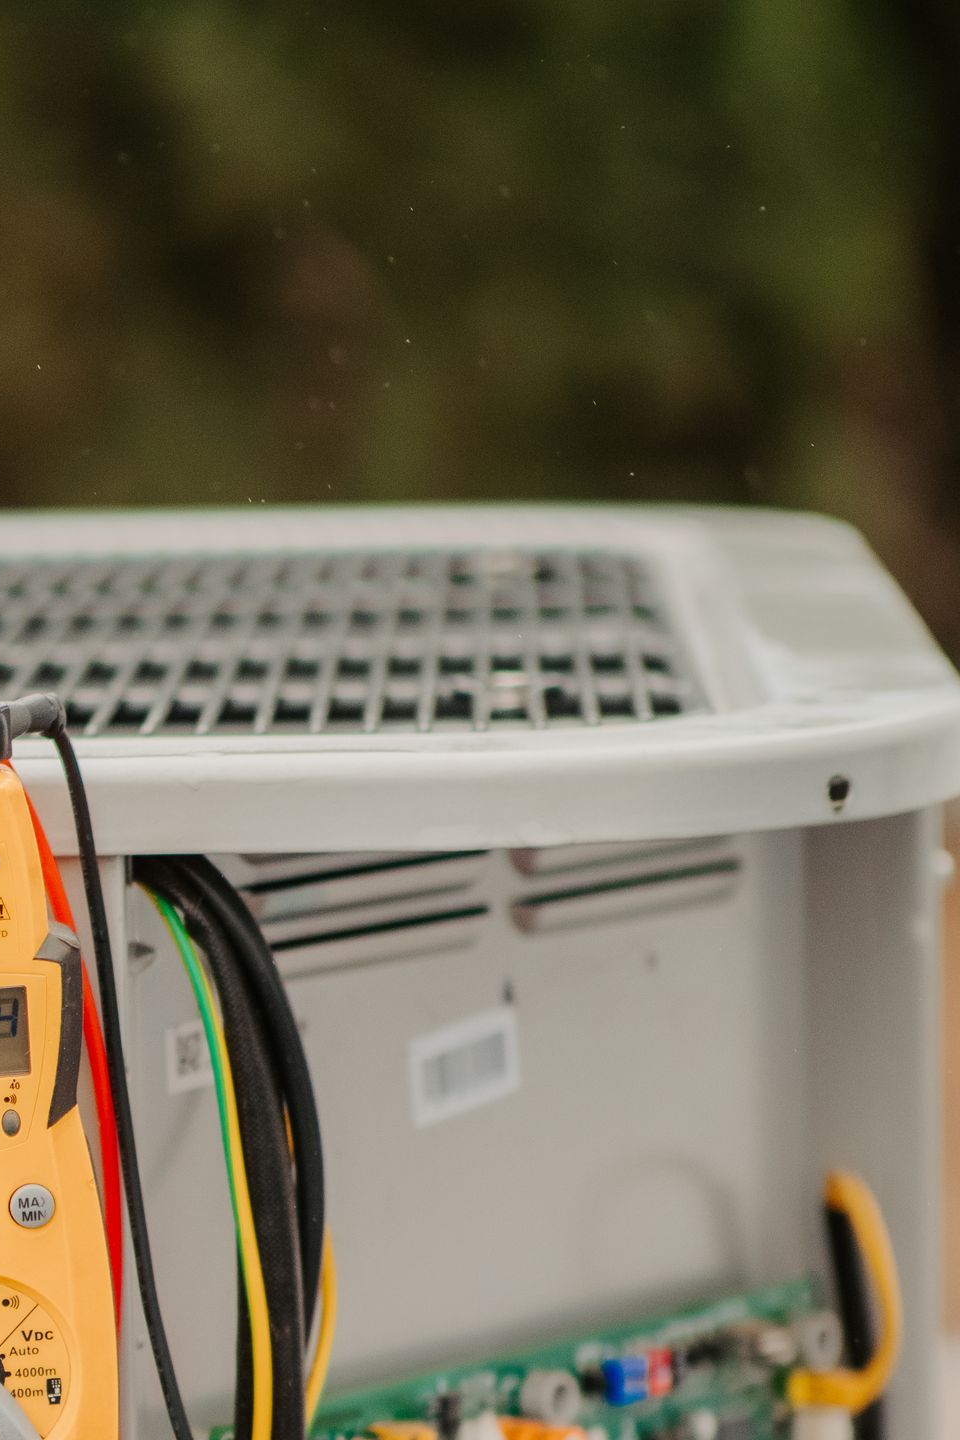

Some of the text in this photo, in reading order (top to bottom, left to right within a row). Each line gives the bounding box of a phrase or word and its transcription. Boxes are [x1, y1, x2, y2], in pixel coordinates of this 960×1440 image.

[9, 1082, 20, 1090] 40
[22, 1330, 54, 1341] VDC
[9, 1346, 39, 1356] Auto
[15, 1367, 56, 1378] 4000m
[11, 1387, 43, 1398] 400m
